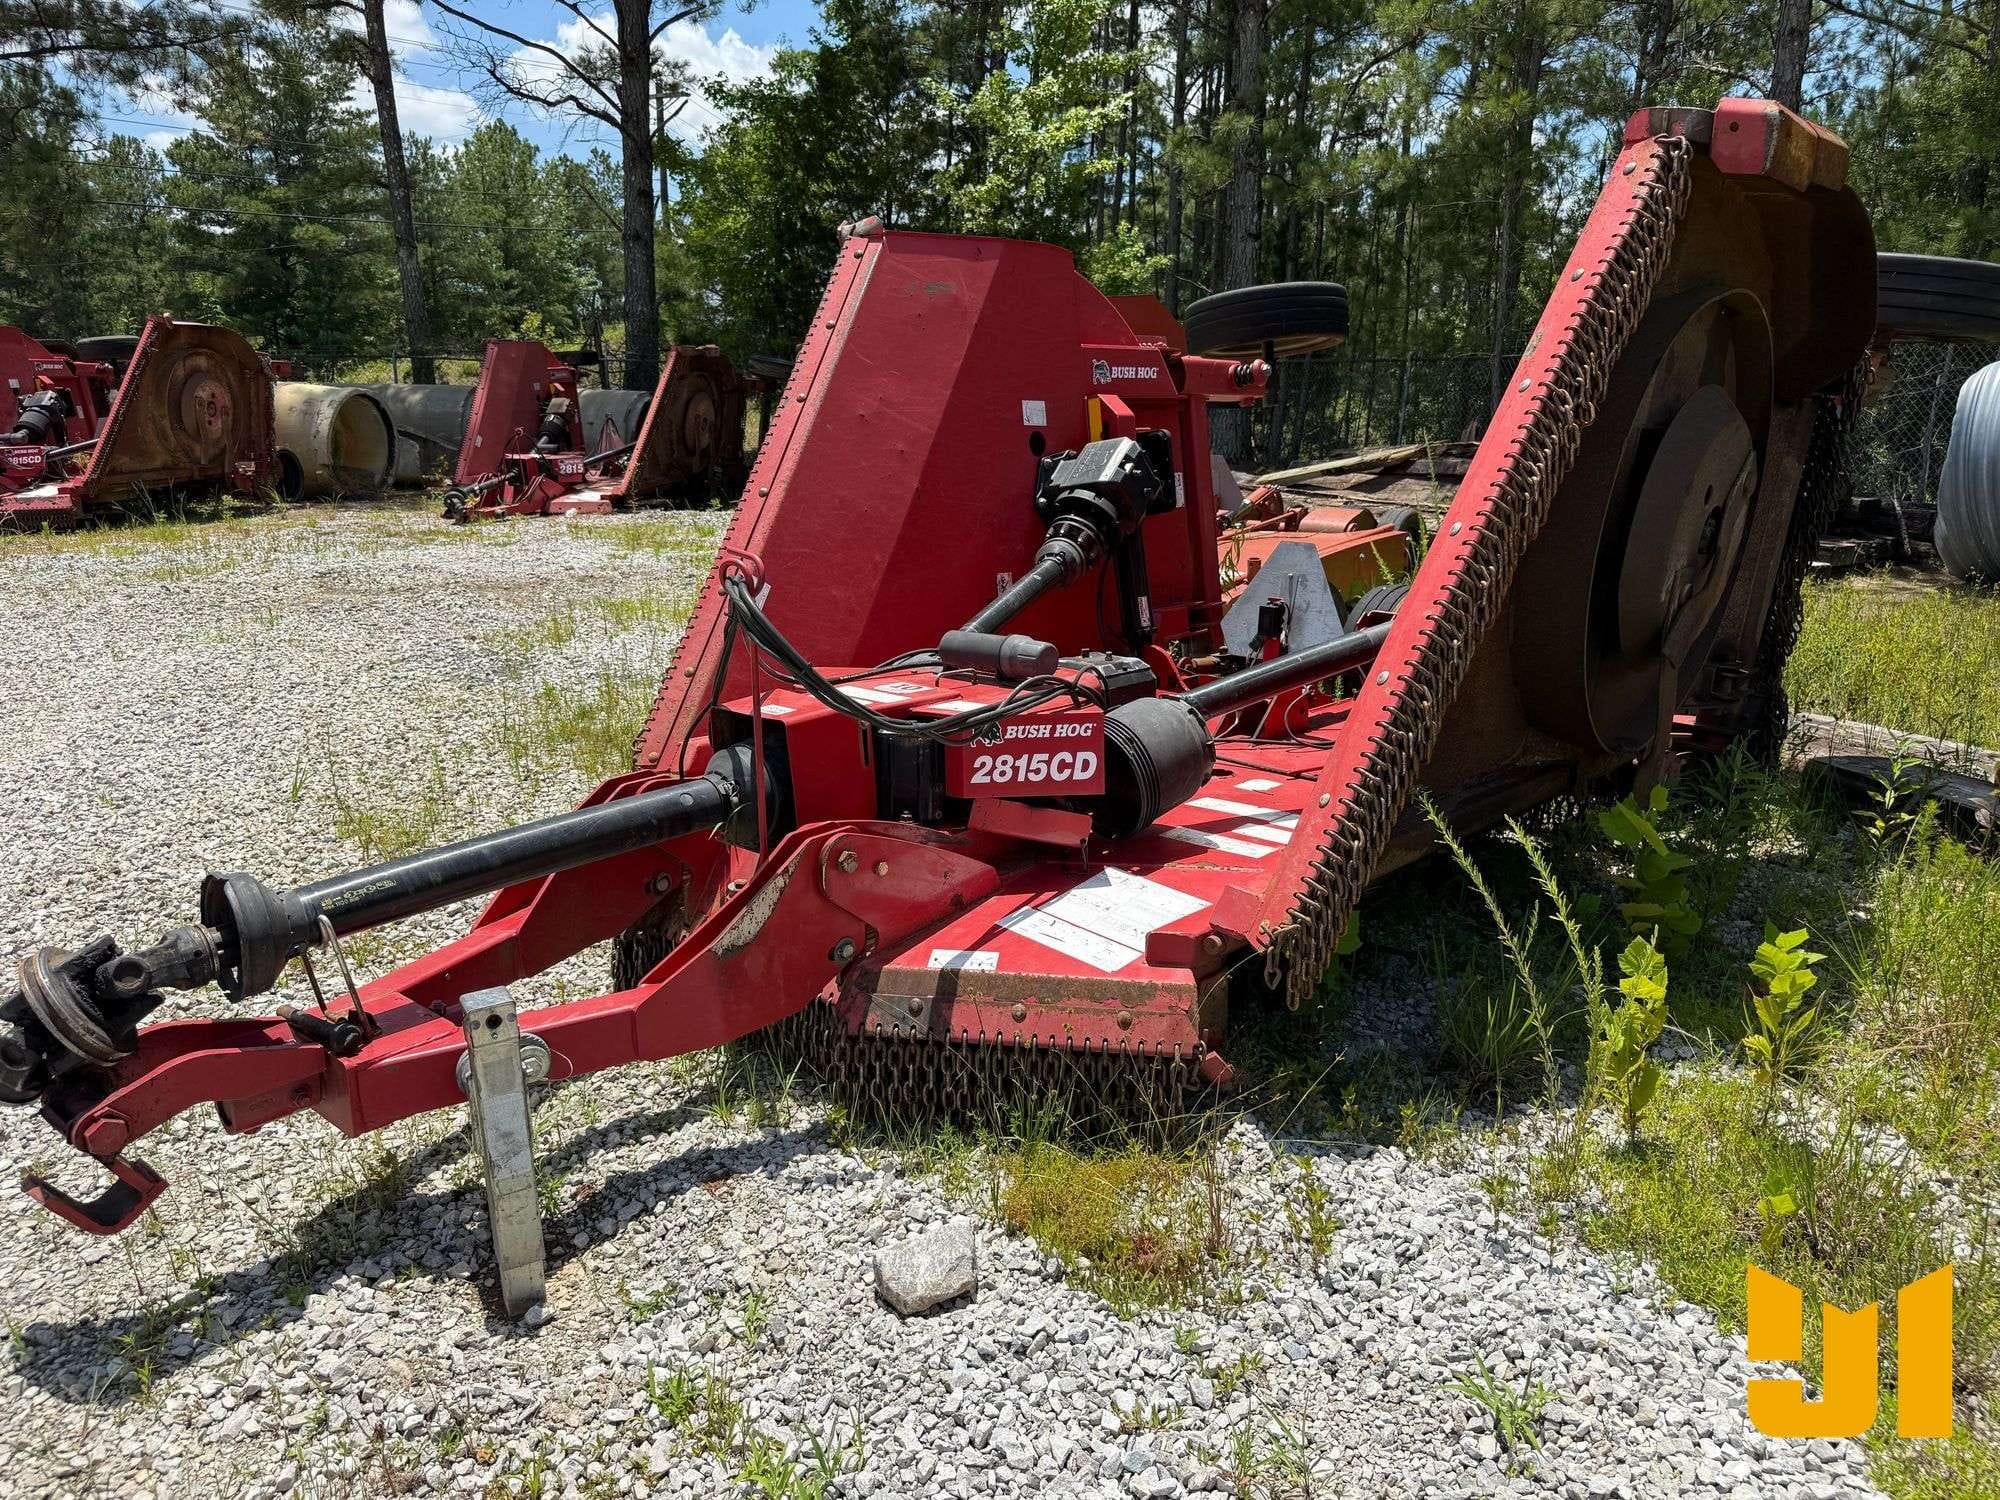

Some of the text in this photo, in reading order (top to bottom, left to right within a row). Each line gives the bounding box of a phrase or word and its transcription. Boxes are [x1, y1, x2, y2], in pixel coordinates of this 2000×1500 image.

[1111, 366, 1157, 379] BUSH HOG
[560, 464, 584, 474] 2815
[1004, 723, 1093, 739] BUSH HOG
[970, 751, 1098, 784] 2815CD
